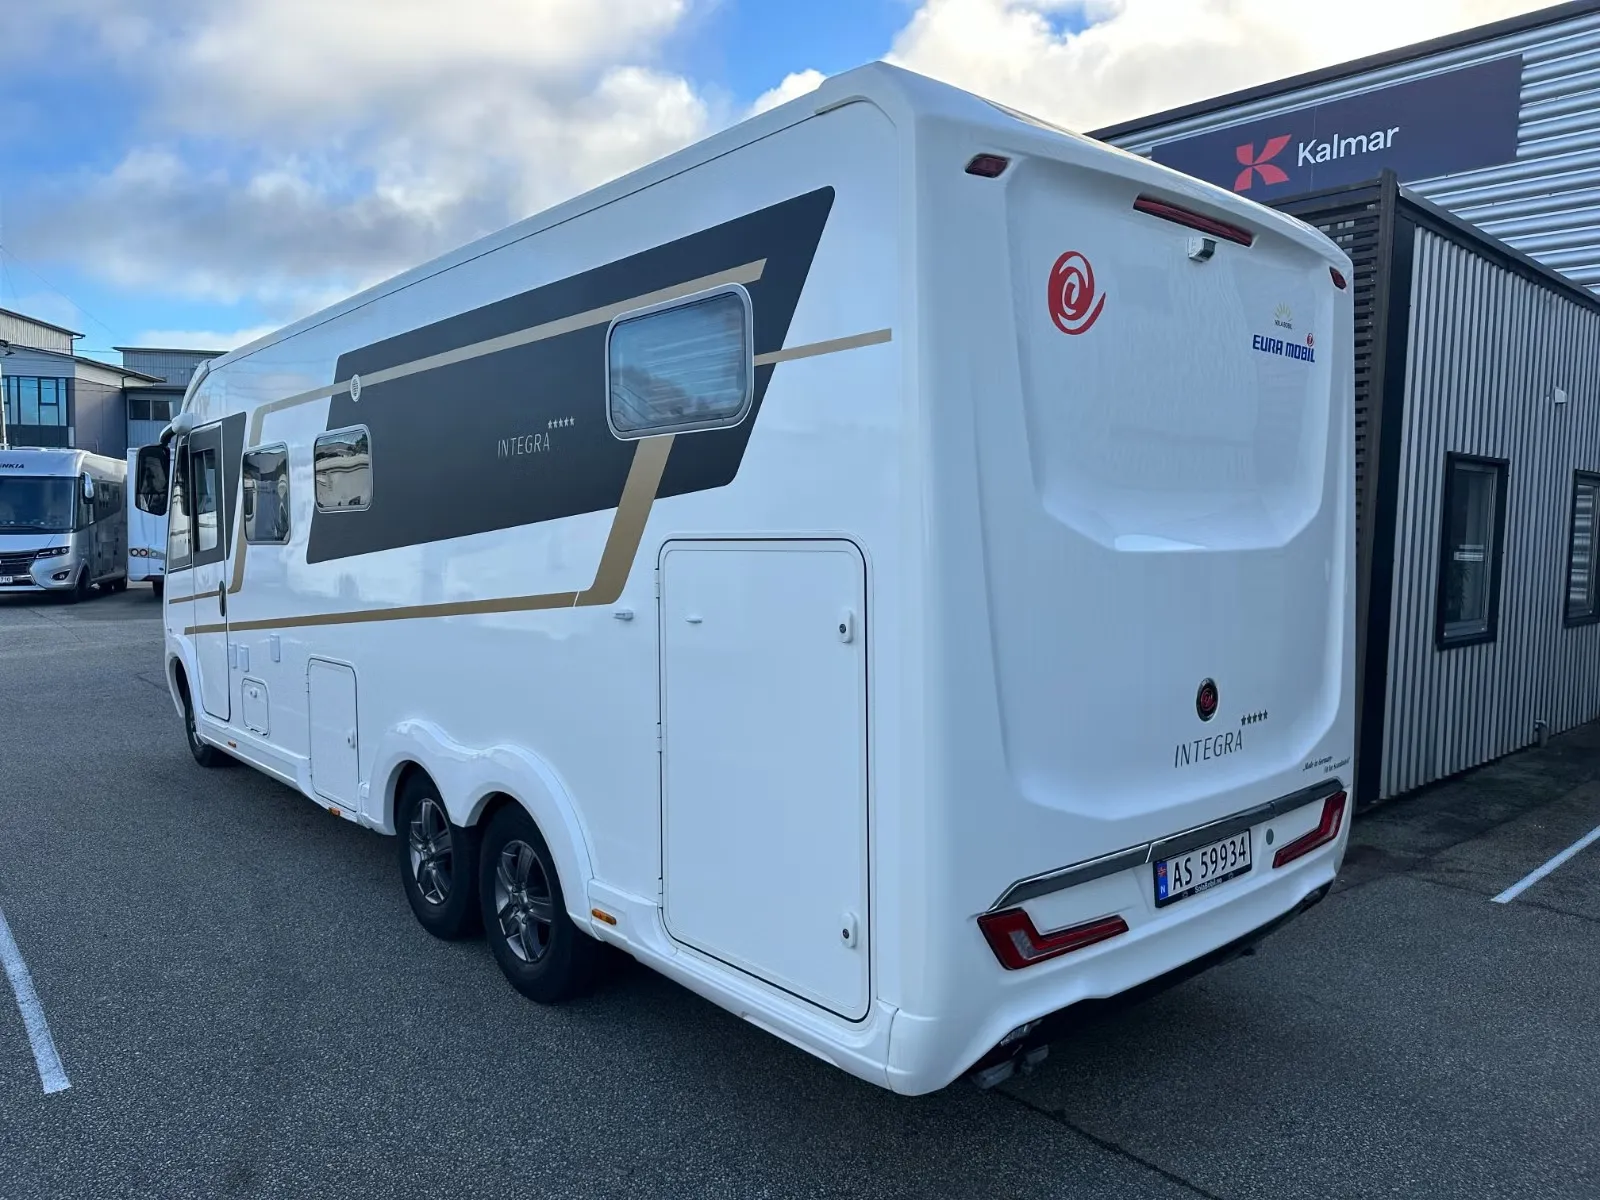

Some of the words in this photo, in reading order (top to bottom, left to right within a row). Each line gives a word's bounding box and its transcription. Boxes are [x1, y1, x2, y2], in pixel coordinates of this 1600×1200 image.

[1297, 126, 1400, 167] Kalmar
[1252, 334, 1284, 356] EURA
[1285, 341, 1316, 363] MOBIL
[497, 432, 550, 458] INTEGRA
[1174, 728, 1243, 768] INTEGRA
[1172, 856, 1193, 891] AS
[1200, 836, 1246, 879] 59934
[1160, 884, 1166, 895] N
